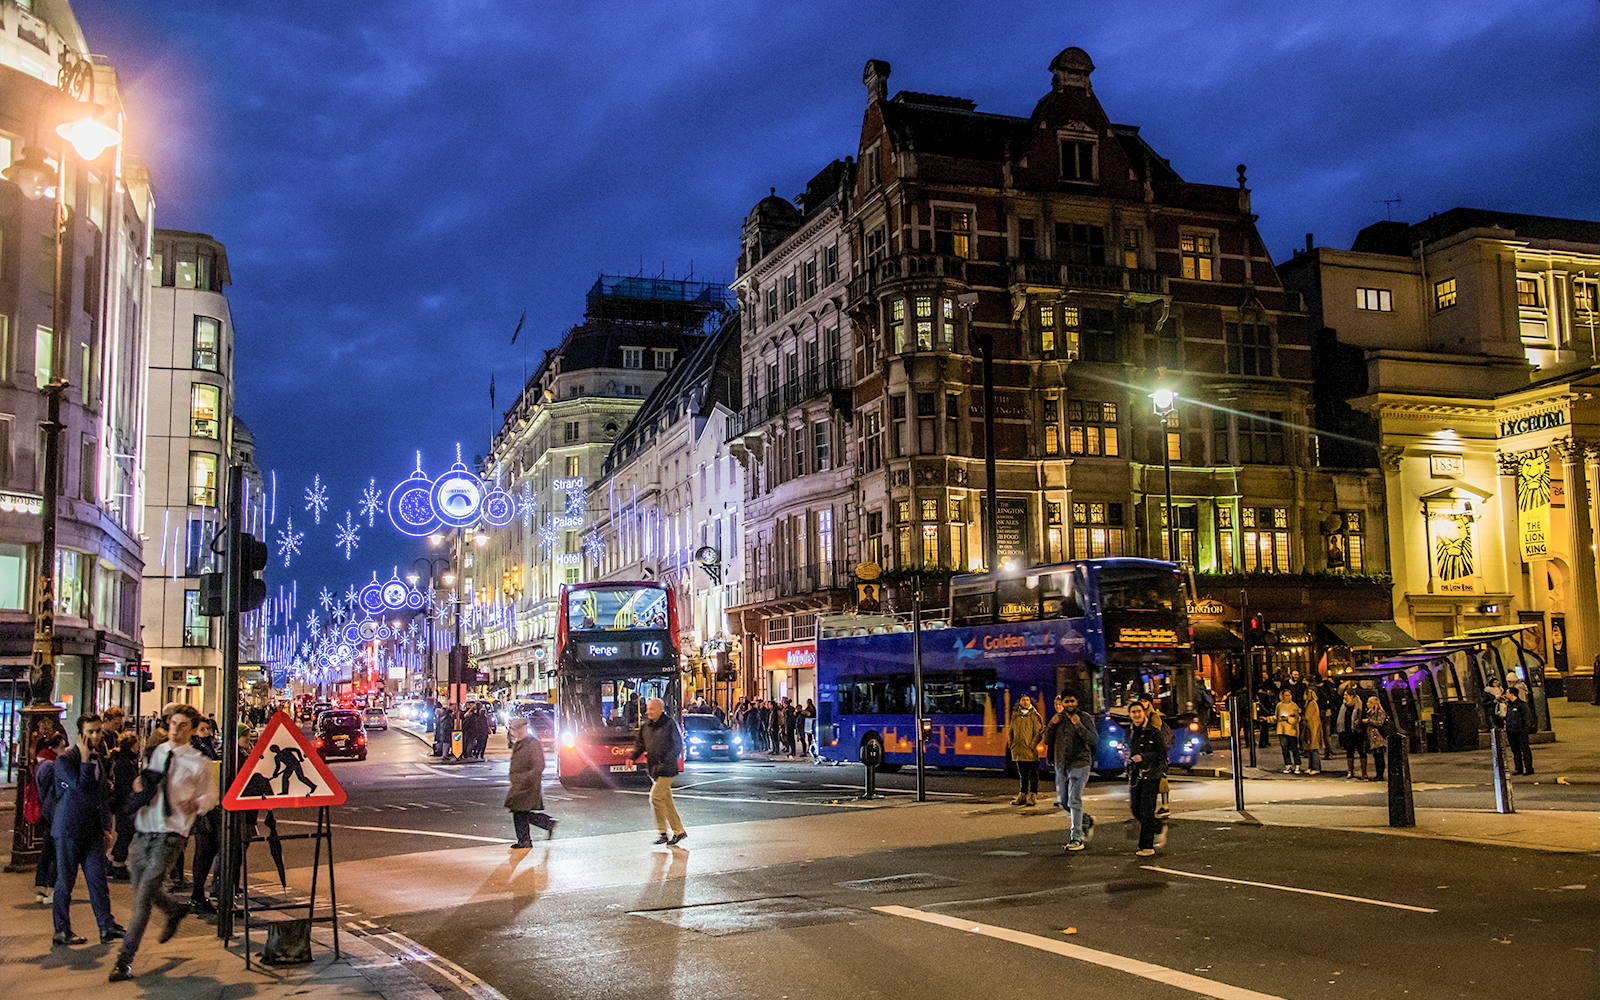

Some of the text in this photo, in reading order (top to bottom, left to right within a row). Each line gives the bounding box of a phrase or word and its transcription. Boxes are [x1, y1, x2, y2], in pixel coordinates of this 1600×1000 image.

[1500, 410, 1564, 437] LYCEUM
[1434, 459, 1459, 471] 1834
[553, 476, 584, 491] Strand
[10, 496, 41, 507] HOUSE
[553, 515, 584, 528] Palace
[1527, 521, 1541, 530] THE
[1525, 532, 1545, 542] LION
[1525, 544, 1547, 554] KING
[556, 552, 582, 565] Hotel
[589, 641, 660, 657] Penge 176
